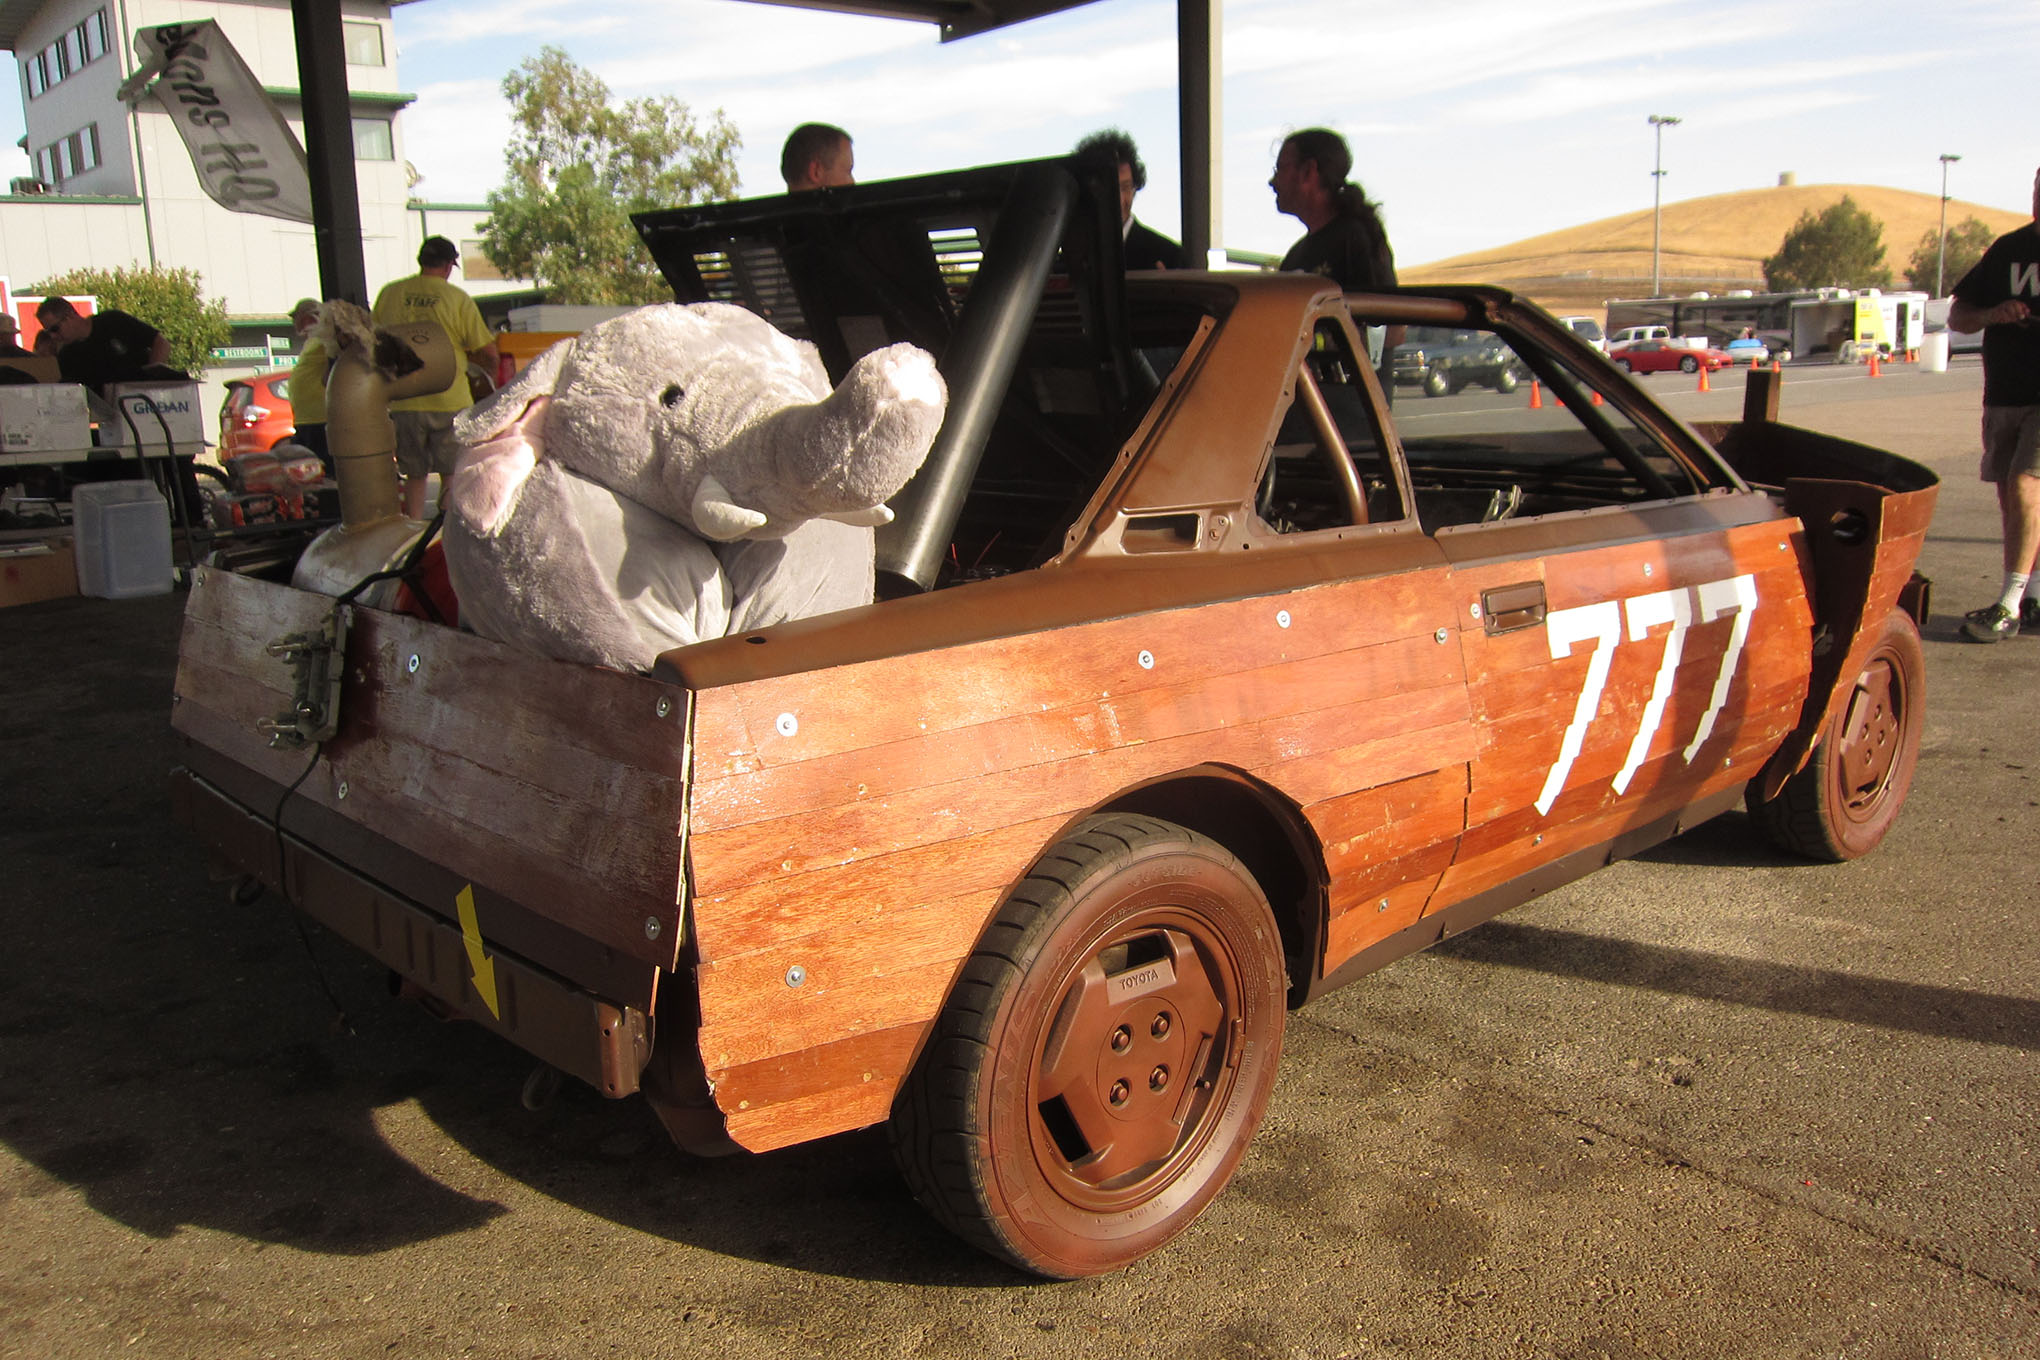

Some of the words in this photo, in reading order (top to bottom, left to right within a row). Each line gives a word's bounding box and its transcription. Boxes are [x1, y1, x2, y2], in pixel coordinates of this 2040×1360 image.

[224, 348, 265, 358] RESTROOMS
[1533, 574, 1758, 817] 777
[1119, 968, 1159, 991] TOYOTA
